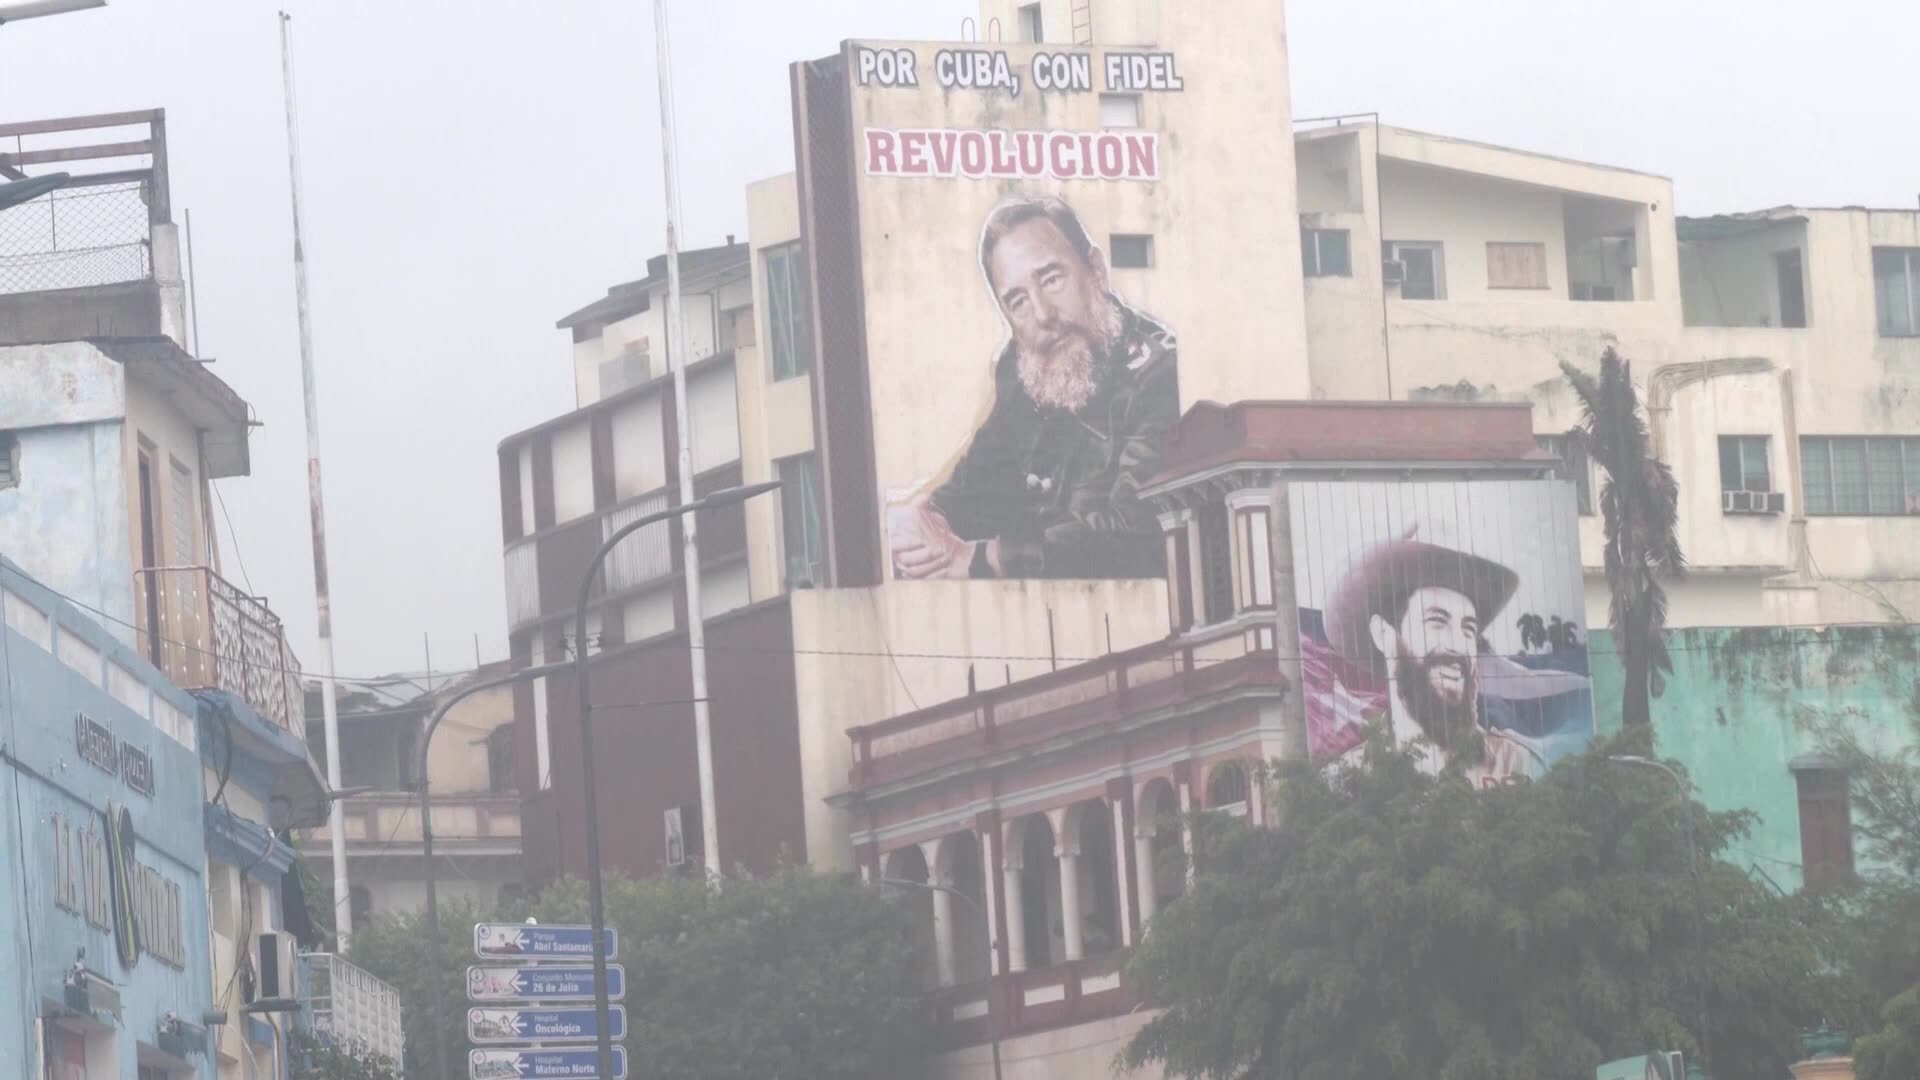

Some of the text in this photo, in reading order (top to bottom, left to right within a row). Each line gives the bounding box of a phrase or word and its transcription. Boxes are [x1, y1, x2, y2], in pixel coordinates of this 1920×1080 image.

[859, 49, 1183, 97] POR CUBA, CON FIDEL
[533, 982, 579, 993] 26 de Julio
[535, 1023, 581, 1035] Oncológico
[536, 1064, 596, 1075] Materno Norte
